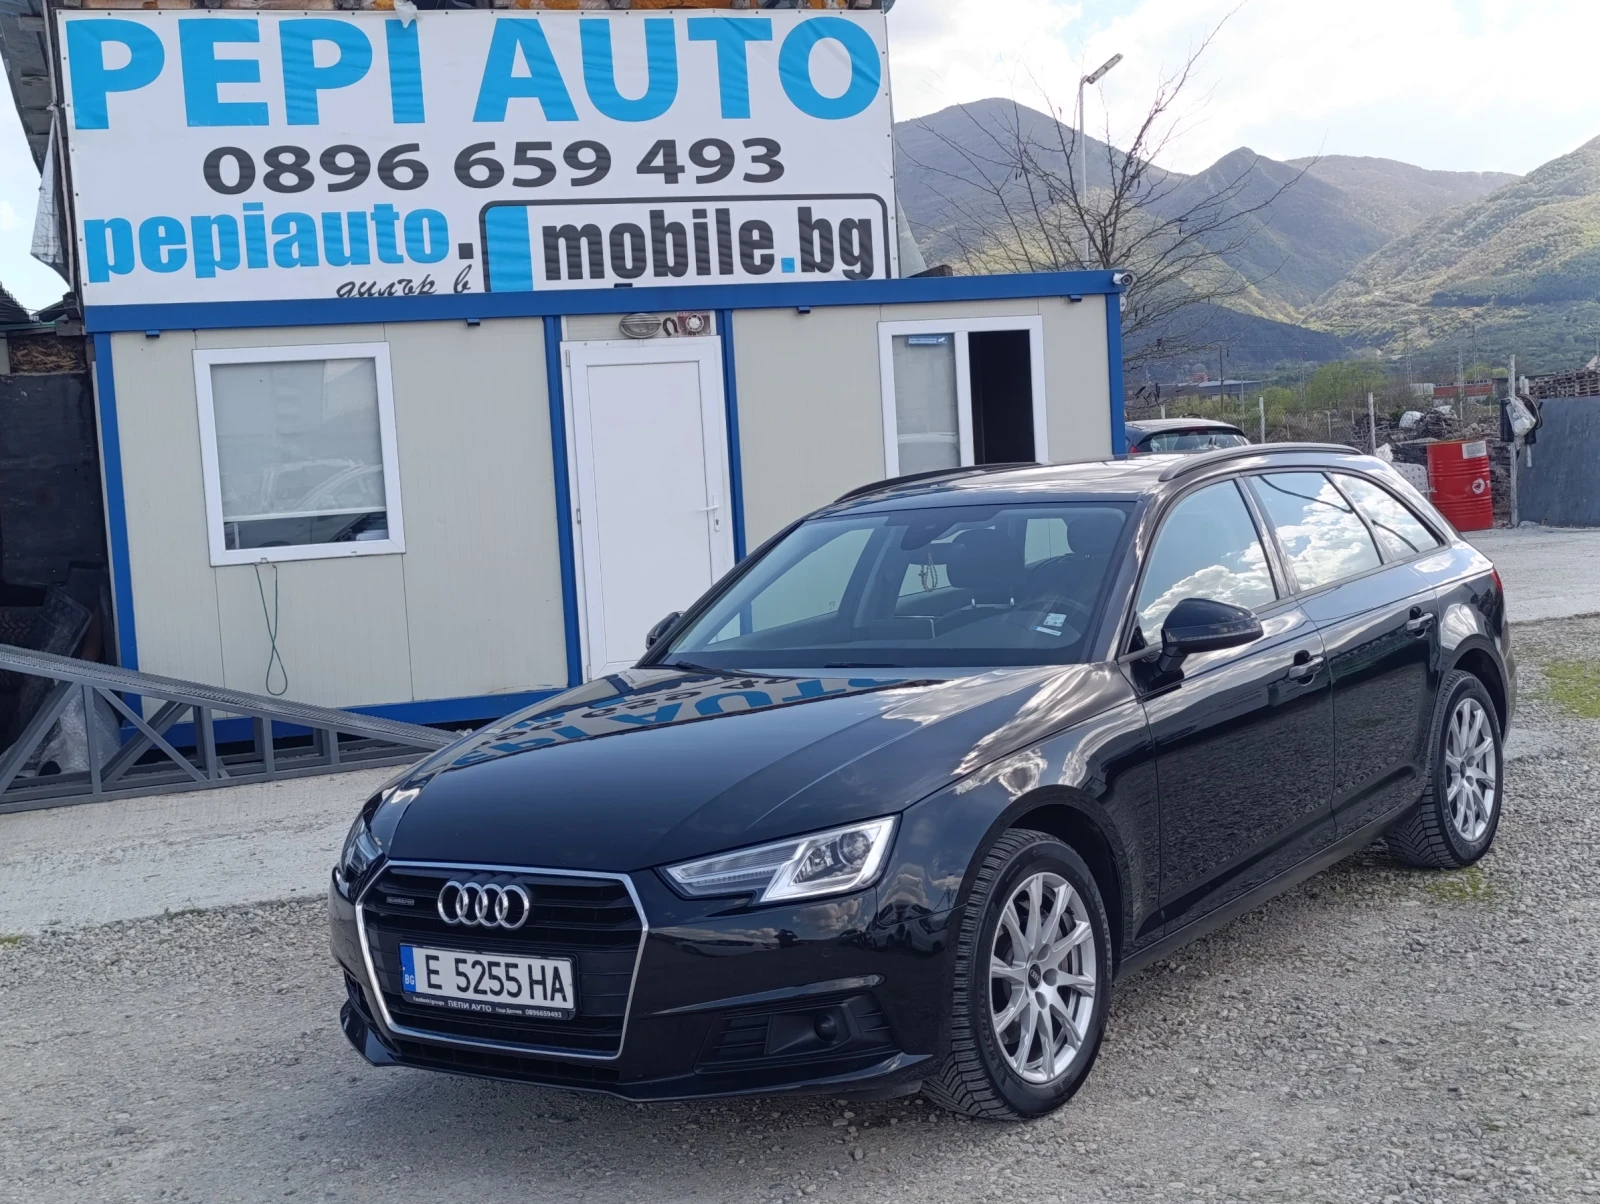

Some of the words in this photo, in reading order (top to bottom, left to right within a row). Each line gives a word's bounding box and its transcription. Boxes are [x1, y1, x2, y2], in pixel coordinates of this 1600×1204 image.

[65, 18, 426, 130] PEPI
[472, 16, 882, 123] AUTO
[203, 143, 430, 195] 0896
[454, 139, 612, 189] 659
[636, 137, 785, 185] 493
[542, 206, 875, 281] mobile.bg
[404, 974, 415, 985] BG
[425, 954, 443, 990] E
[454, 957, 522, 998] 5255
[528, 964, 568, 1003] HA
[448, 1000, 470, 1009] ПЕПИ
[471, 1003, 492, 1012] АУТО
[525, 1009, 562, 1018] 0896659493
